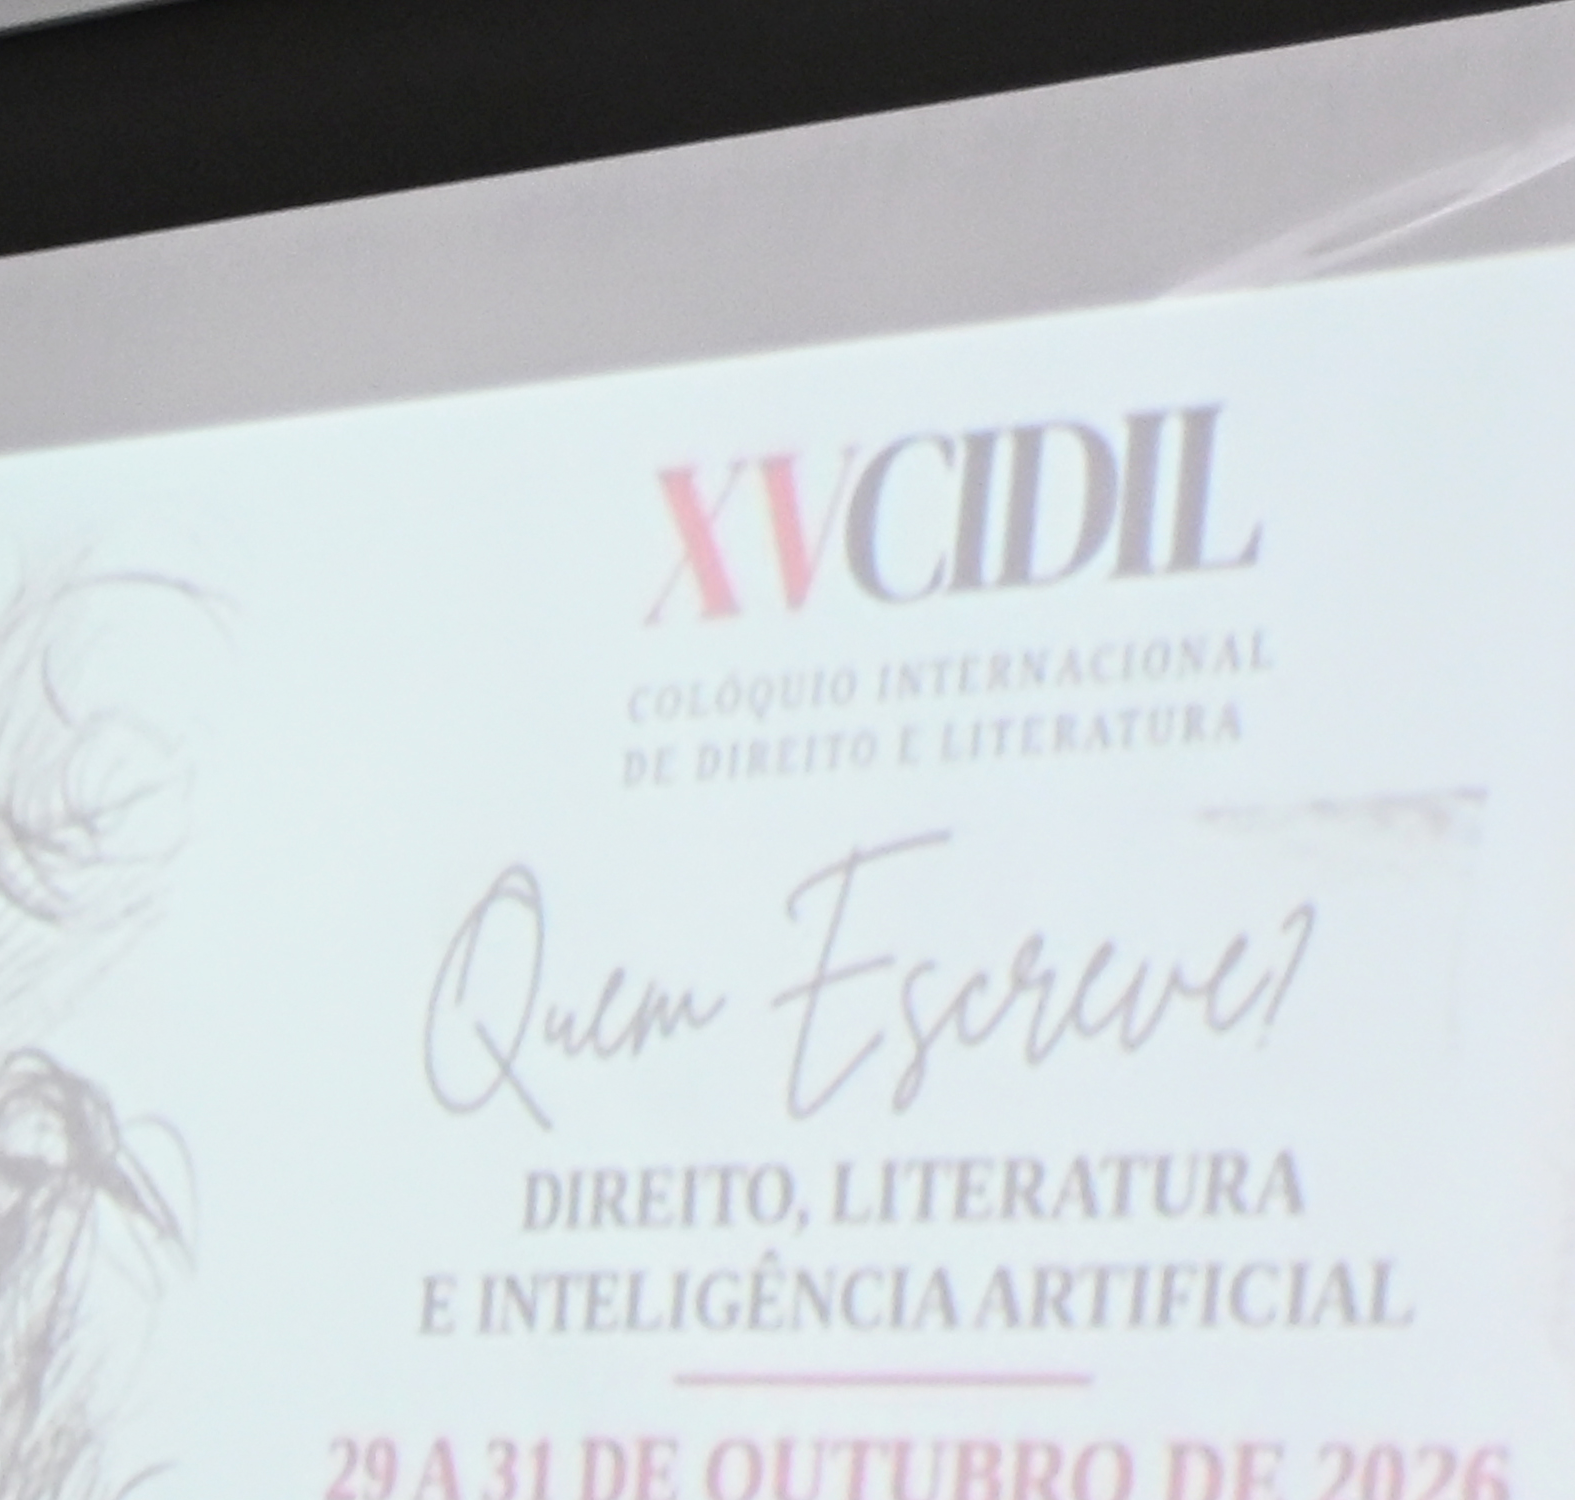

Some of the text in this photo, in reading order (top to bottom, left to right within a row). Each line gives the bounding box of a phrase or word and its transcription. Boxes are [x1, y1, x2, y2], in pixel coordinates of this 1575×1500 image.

[625, 627, 1276, 723] COLÓQUIO INTERNACIONAL
[622, 700, 1244, 788] DE DIREITO E LITERATURA
[423, 828, 1316, 1130] Quem Escreve?
[521, 1147, 1307, 1235] DIREITO, LITERATURA
[418, 1250, 1416, 1336] E INTELIGÊNCIA ARTIFICIAL
